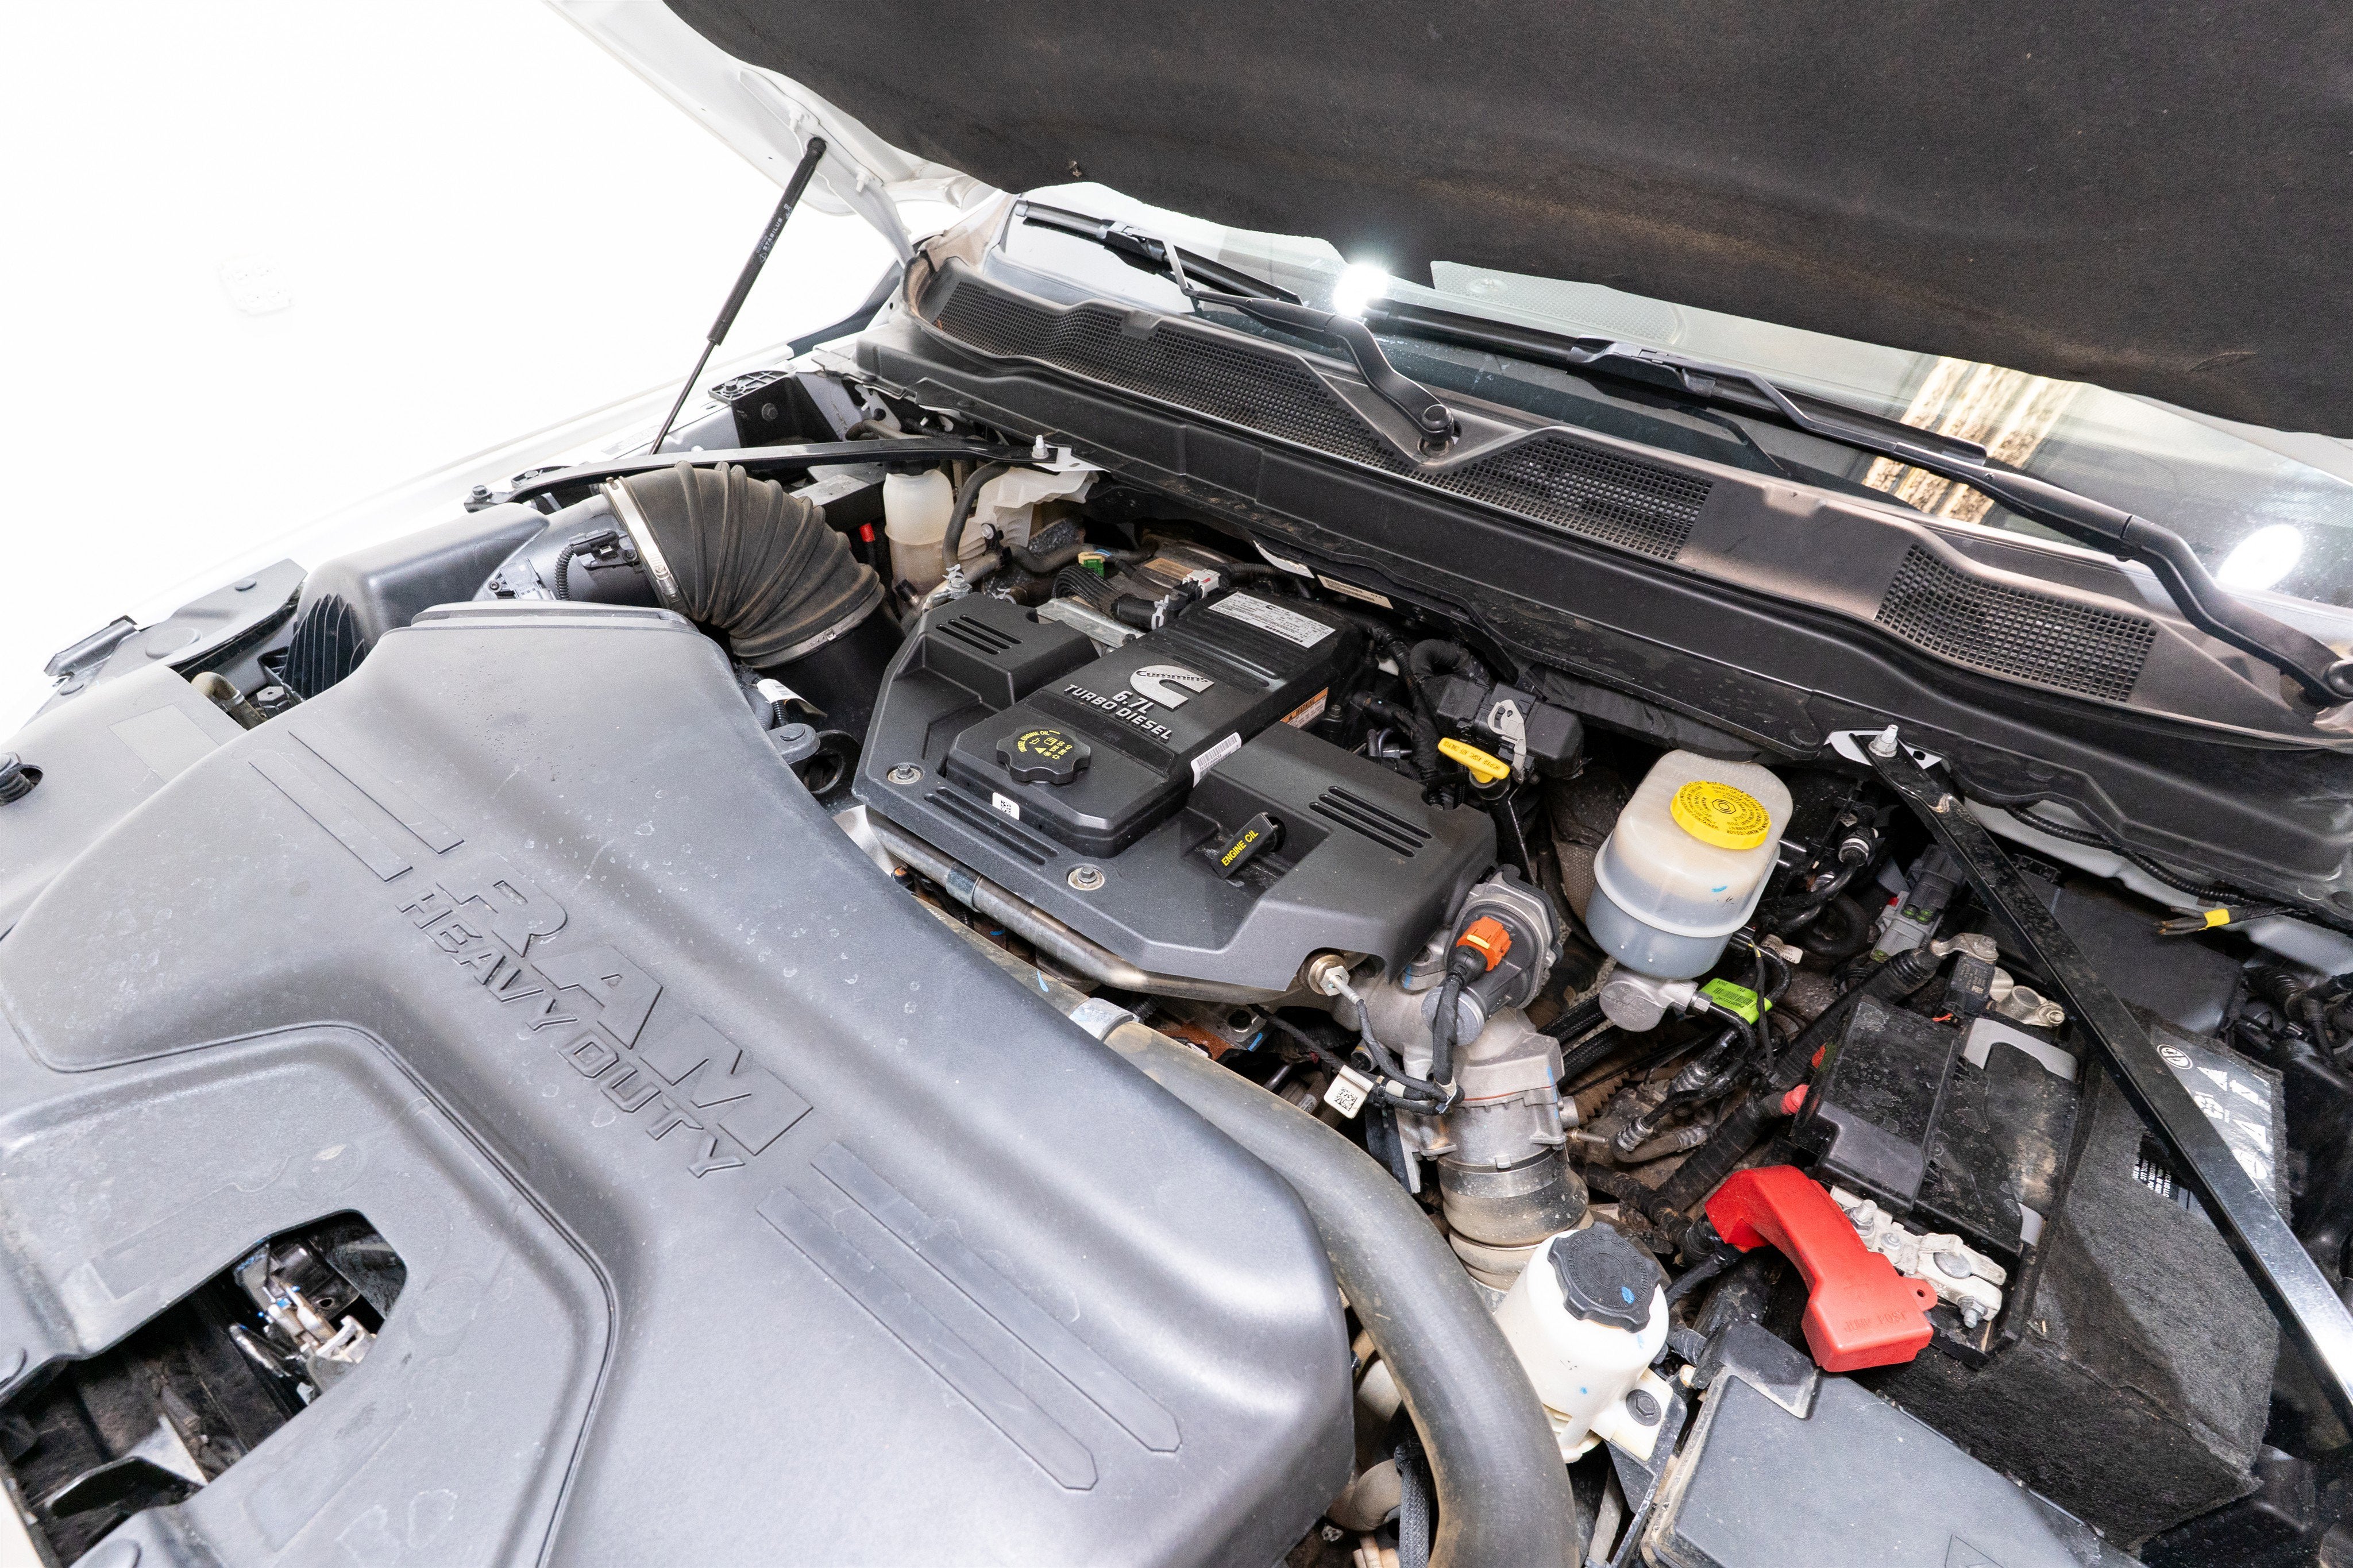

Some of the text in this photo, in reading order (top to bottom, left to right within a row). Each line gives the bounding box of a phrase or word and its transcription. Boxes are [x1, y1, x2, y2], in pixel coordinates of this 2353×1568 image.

[763, 218, 782, 251] STABILUS
[1136, 670, 1208, 683] Cummins
[1064, 684, 1172, 740] TURBO DIESEL
[1112, 690, 1154, 714] 6.7L
[1020, 731, 1040, 741] ENGINE
[1221, 830, 1259, 866] ENGINE OIL
[437, 851, 813, 1157] RAM
[396, 889, 746, 1179] HEAVY DUTY
[1878, 1311, 1906, 1324] POST
